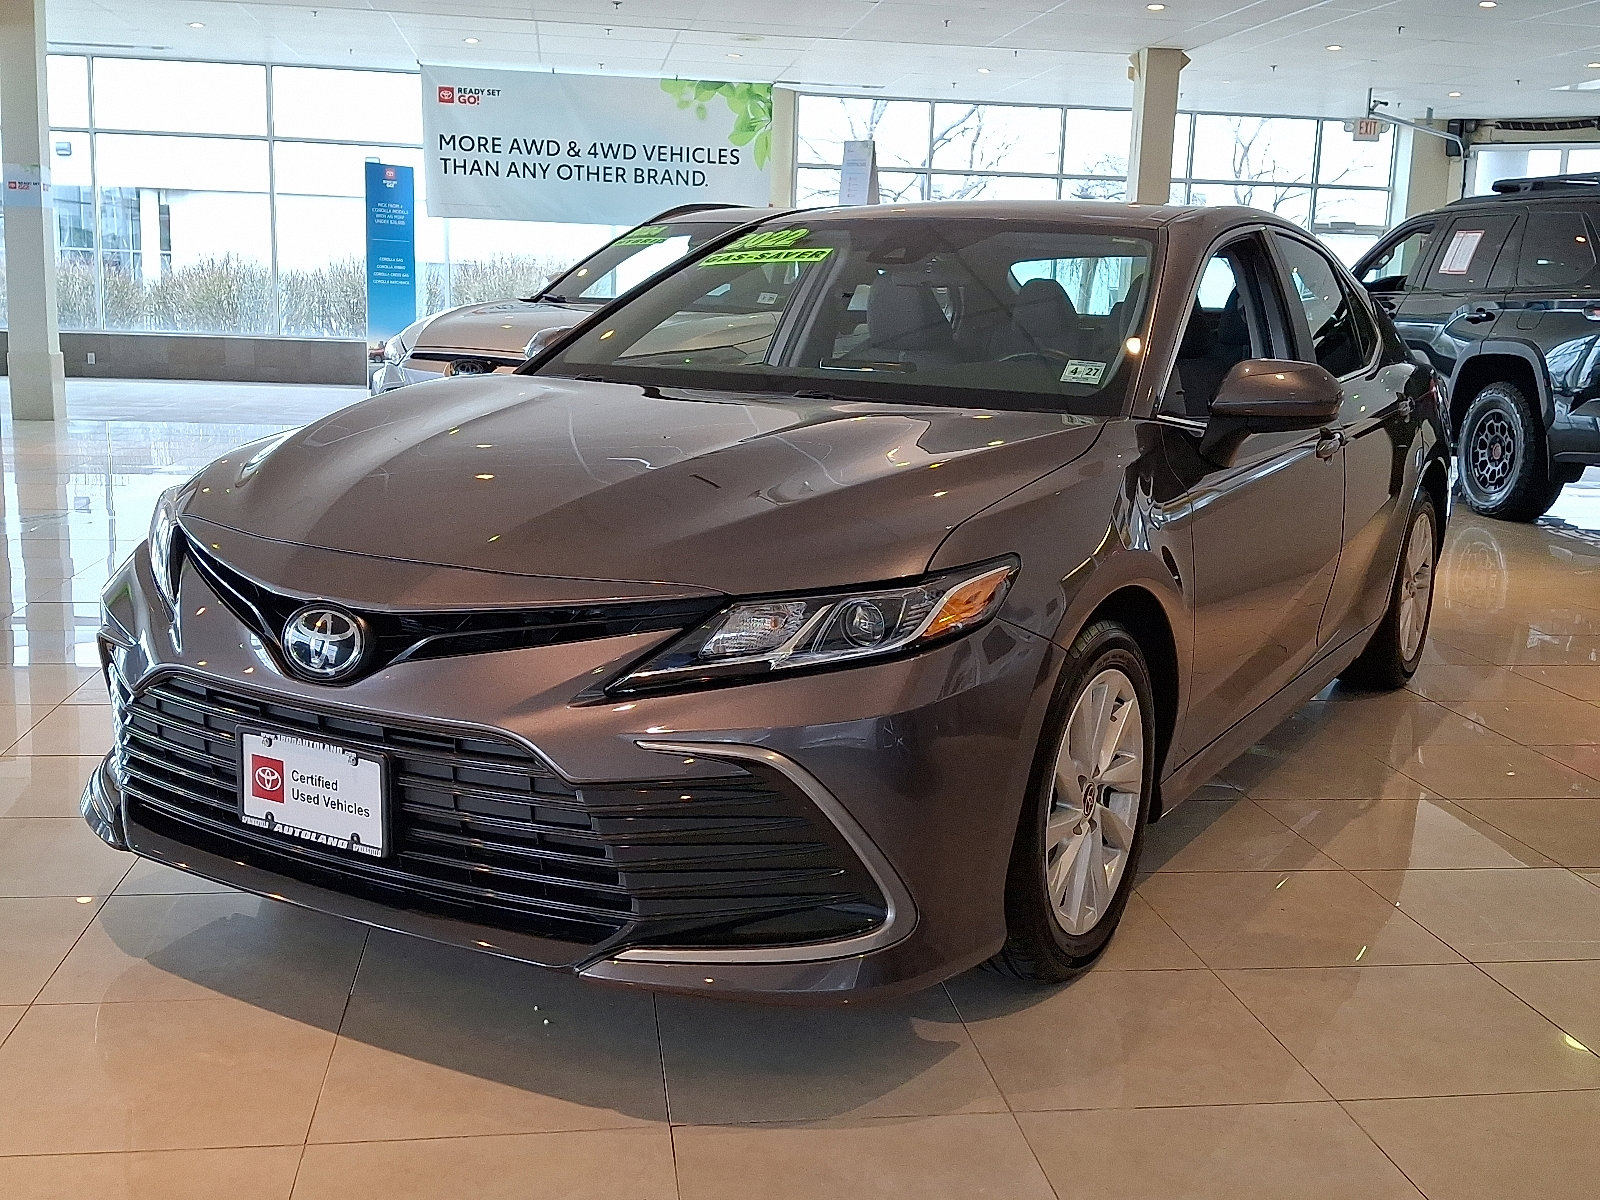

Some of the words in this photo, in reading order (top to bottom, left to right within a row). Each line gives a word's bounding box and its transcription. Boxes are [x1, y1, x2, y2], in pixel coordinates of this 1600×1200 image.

[457, 87, 485, 95] READY
[458, 95, 480, 105] GO!
[1359, 121, 1377, 135] EXIT
[438, 133, 502, 153] MORE
[508, 137, 560, 157] AWD
[566, 141, 581, 158] &
[587, 142, 637, 161] 4WD
[642, 145, 741, 165] VEHICLES
[440, 157, 500, 177] THAN
[506, 161, 551, 179] ANY
[556, 163, 627, 183] OTHER
[634, 167, 709, 187] BRAND.
[723, 228, 810, 250] 2022
[704, 249, 827, 264] GAS-SAVER
[1070, 367, 1079, 376] 4
[1084, 367, 1100, 377] 27
[291, 769, 338, 791] Certified
[291, 788, 320, 806] Used
[322, 795, 371, 818] Vehicles
[273, 823, 348, 849] AUTOLAND
